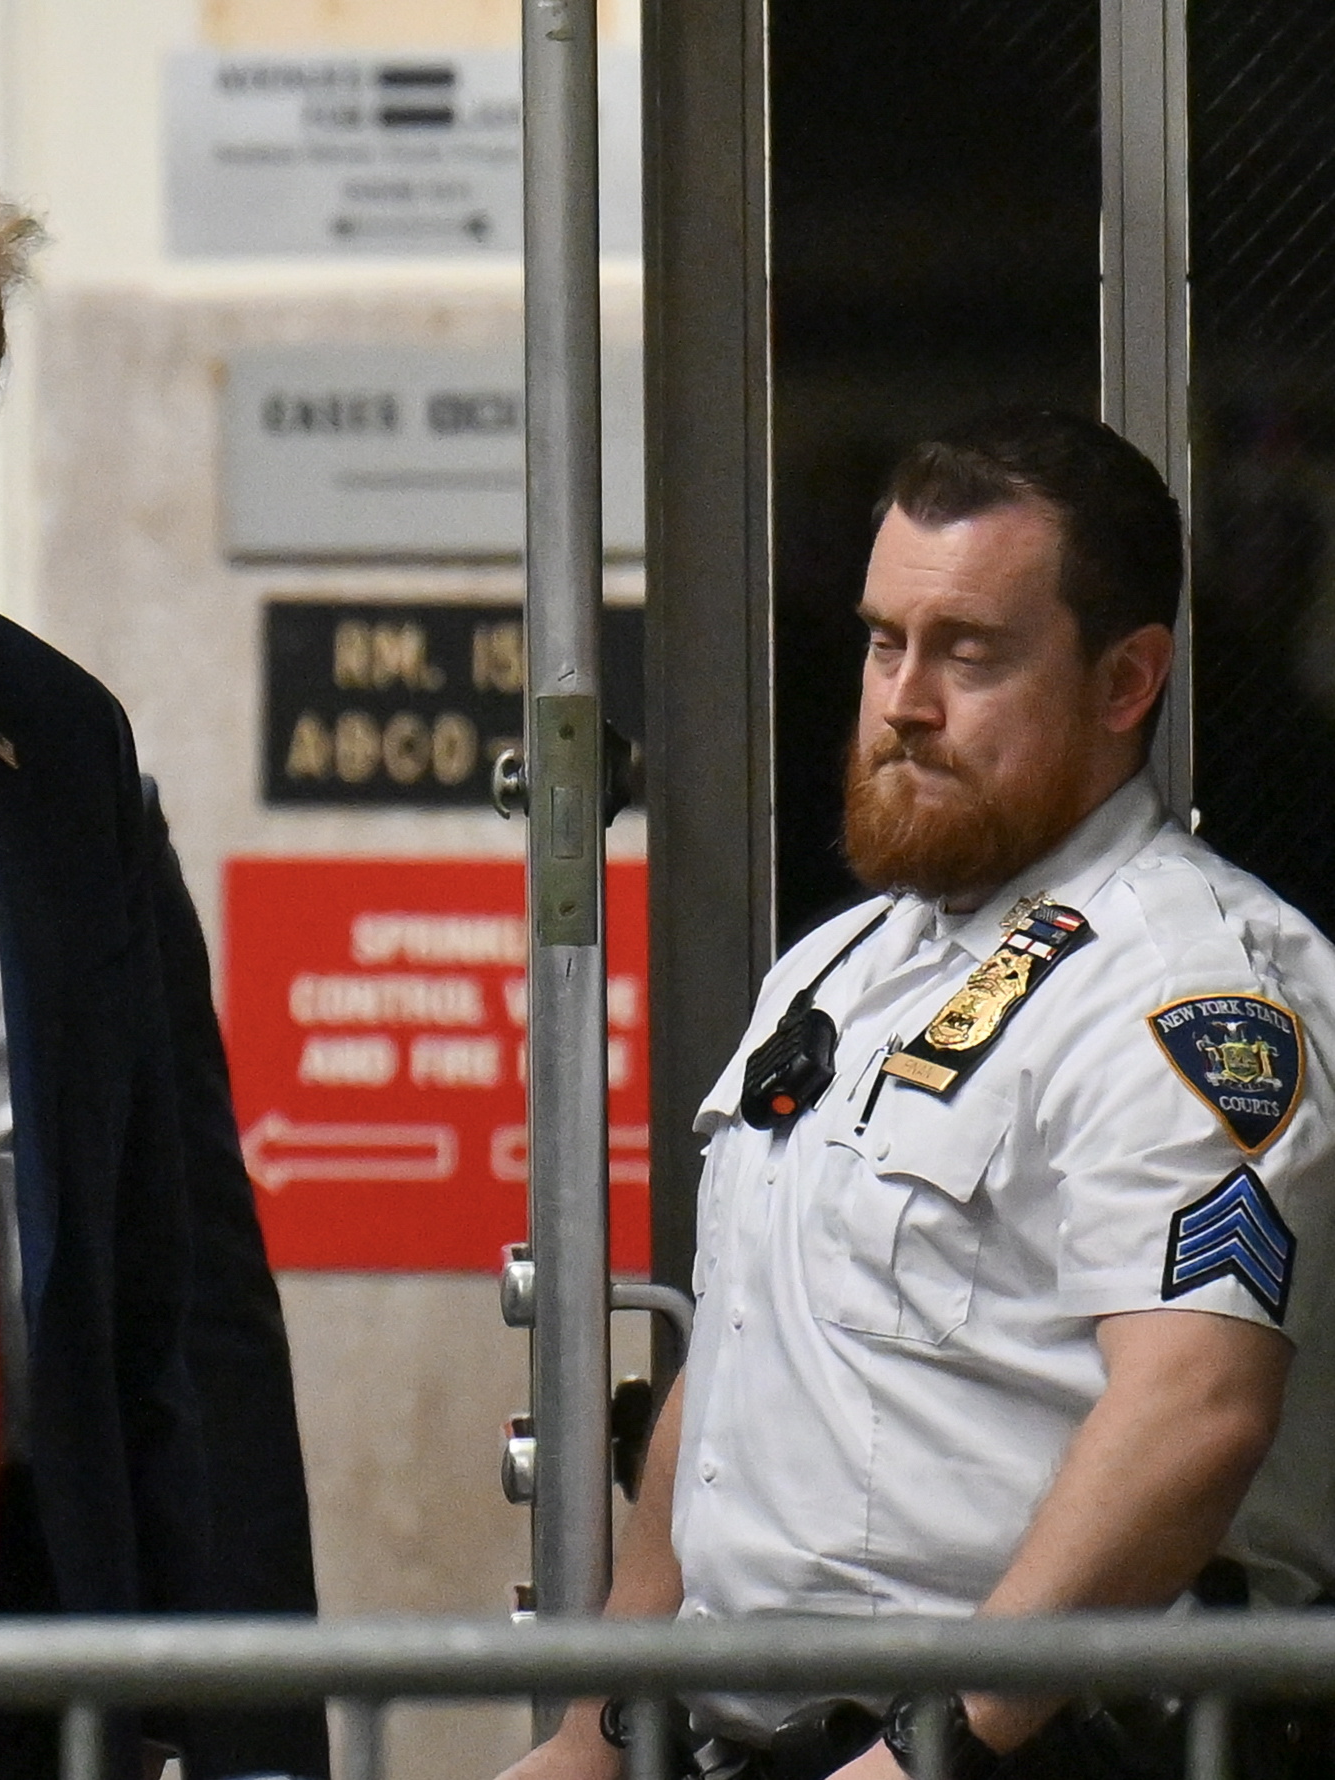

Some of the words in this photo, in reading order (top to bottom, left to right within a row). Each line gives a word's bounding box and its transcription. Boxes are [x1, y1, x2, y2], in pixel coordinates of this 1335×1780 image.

[333, 619, 447, 692] RM.
[472, 620, 525, 693] 15
[351, 914, 527, 966] SPRINKL
[289, 973, 485, 1027] CONTROL
[1157, 1005, 1196, 1034] NEW
[1195, 1000, 1245, 1016] YORK
[1244, 1001, 1291, 1034] STATE
[297, 1034, 400, 1088] AND
[409, 1034, 503, 1089] FIRE
[1218, 1096, 1280, 1117] COURTS
